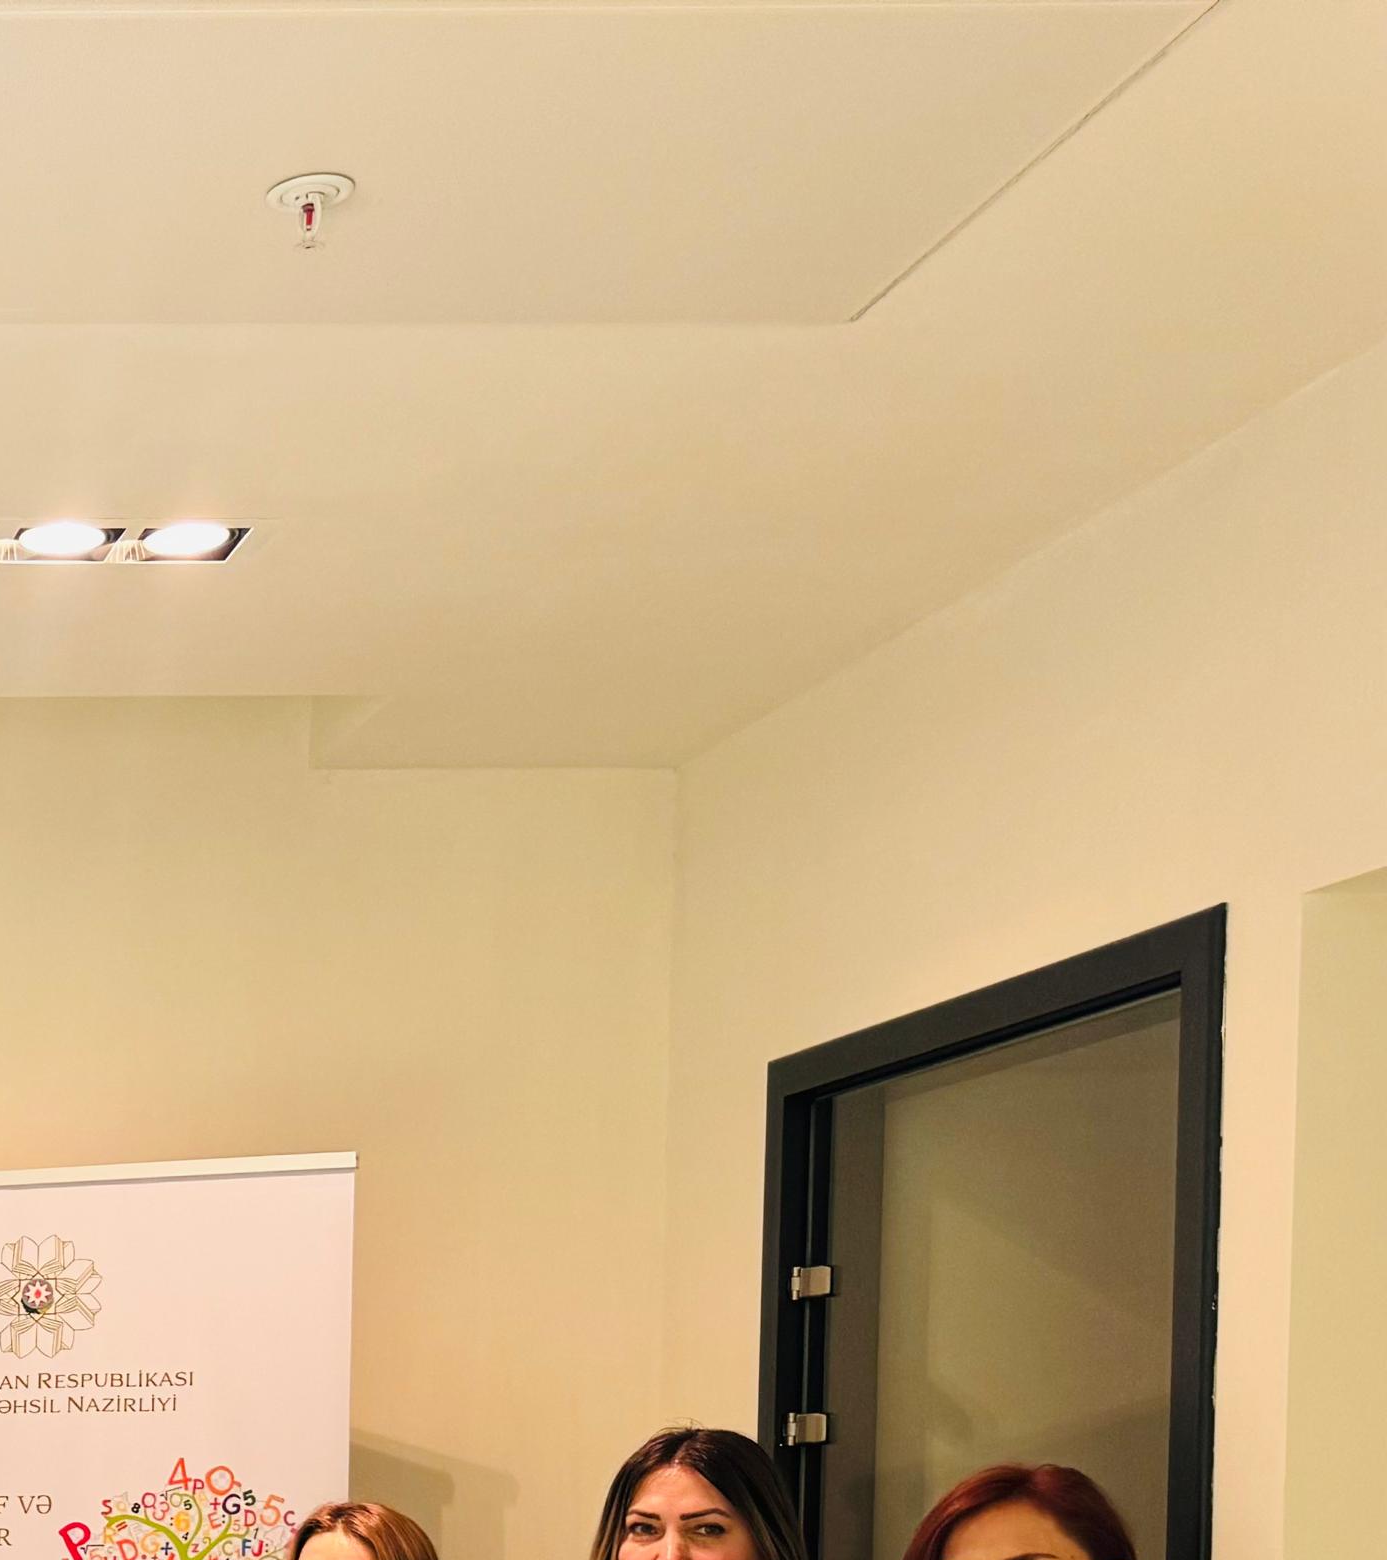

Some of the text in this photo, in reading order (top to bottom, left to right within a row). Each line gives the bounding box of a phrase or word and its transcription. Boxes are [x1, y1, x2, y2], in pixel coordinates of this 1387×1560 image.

[37, 1370, 194, 1389] RESPUBLİKASI
[67, 1393, 178, 1414] NAZİRLİYİ
[18, 1495, 53, 1514] VƏ
